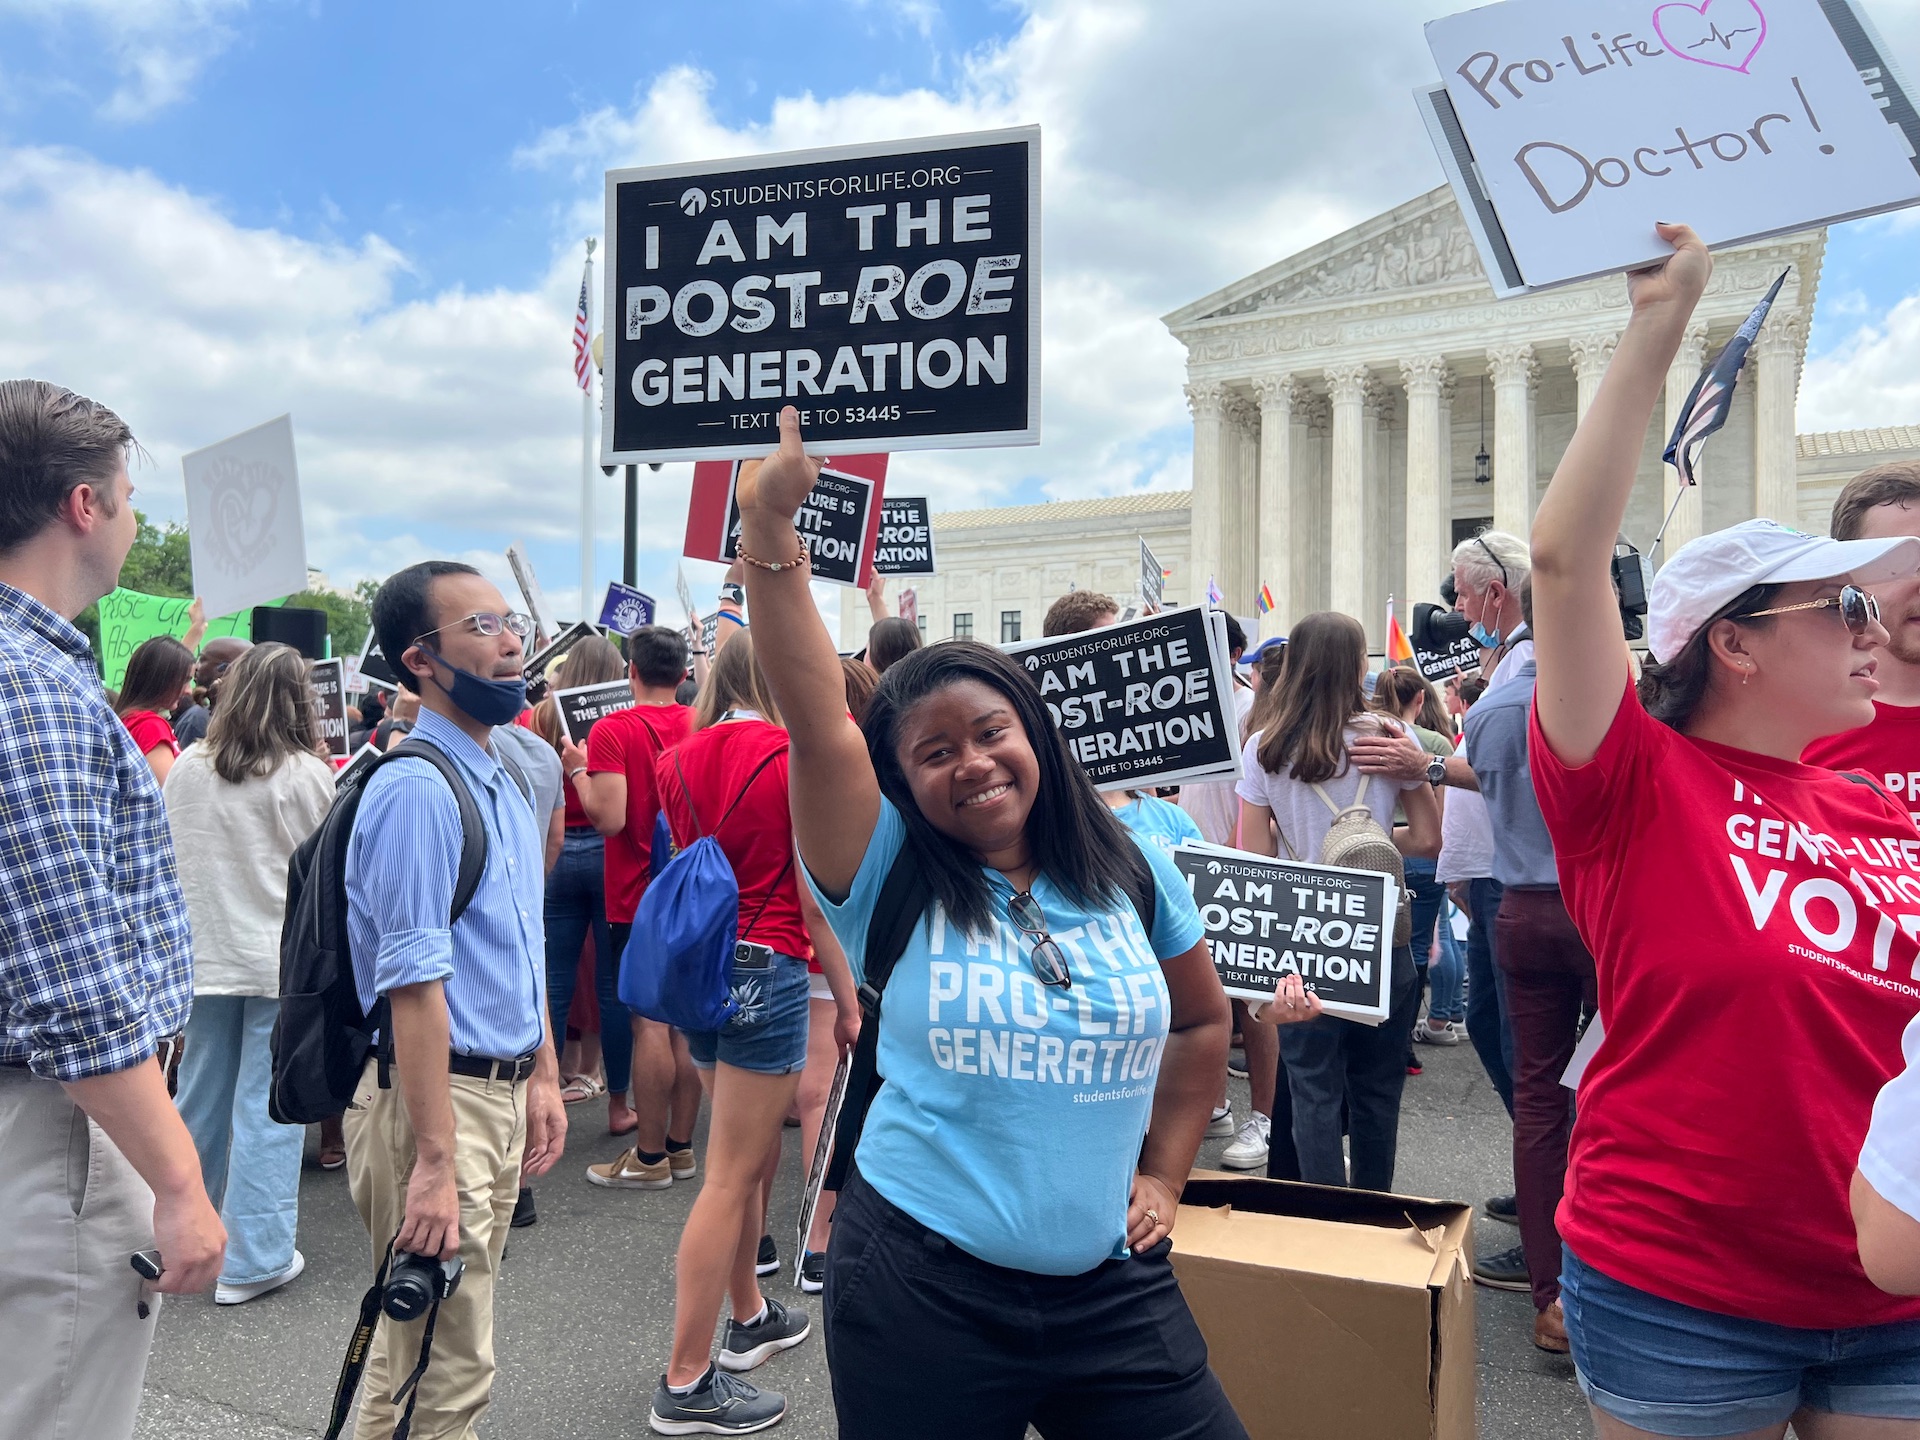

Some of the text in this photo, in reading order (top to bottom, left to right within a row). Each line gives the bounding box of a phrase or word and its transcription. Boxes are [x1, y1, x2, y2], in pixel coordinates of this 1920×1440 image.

[1457, 32, 1663, 109] Pro-Life
[1514, 77, 1835, 214] Doctor!
[711, 166, 961, 207] STUDENTSFORLIFE.ORG
[645, 194, 992, 270] I AM THE
[625, 254, 1021, 340] POST-ROE
[1354, 297, 1582, 339] EQUAL JUSTICE UNDER LAW
[631, 335, 1007, 407] GENERATION
[730, 405, 901, 430] TEXT LE TO 53445
[842, 500, 856, 515] IS
[880, 510, 920, 524] THE
[1040, 625, 1170, 666] STUDENTSFORLIFE.ORG
[1040, 638, 1192, 696] AM THE
[572, 707, 599, 722] THE
[1047, 668, 1209, 730] OST-ROE
[1098, 763, 1117, 776] LIFE
[1118, 761, 1132, 771] TO
[1133, 755, 1163, 769] 53445
[1223, 864, 1352, 889] STUDENTSFORLIFE.ORG
[1213, 878, 1273, 906] AM
[1292, 887, 1366, 917] THE
[1200, 903, 1379, 952] OST-ROE
[1205, 938, 1371, 984] NERATION
[1226, 971, 1248, 982] TEXT
[1250, 973, 1269, 985] LIFE
[350, 1325, 371, 1364] Nikon
